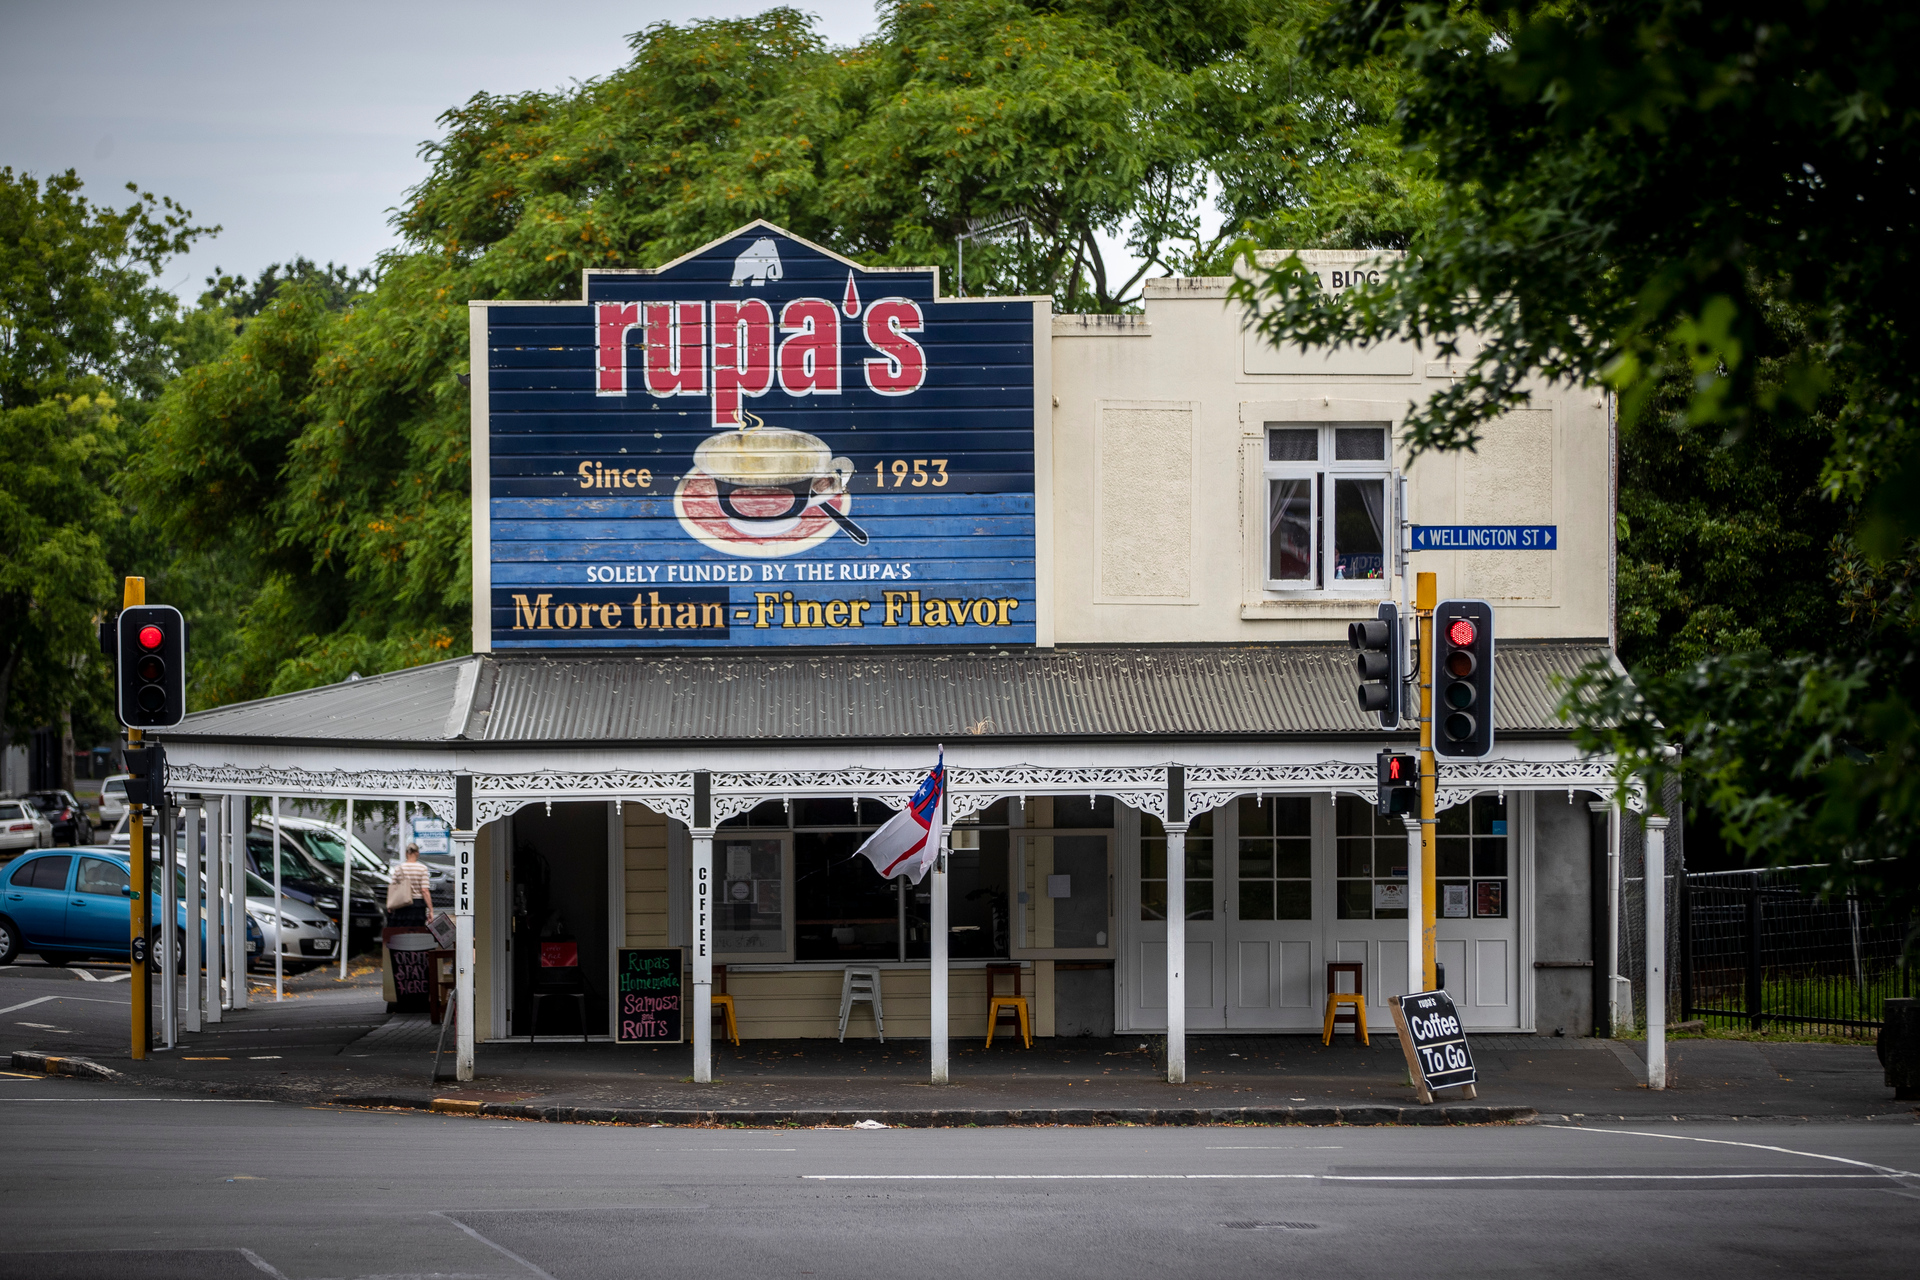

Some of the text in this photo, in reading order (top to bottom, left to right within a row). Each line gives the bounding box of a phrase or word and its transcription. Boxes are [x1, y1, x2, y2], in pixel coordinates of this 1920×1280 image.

[1332, 270, 1380, 288] BLDG
[594, 268, 927, 428] rupa's
[578, 459, 949, 488] Since 1953
[1429, 529, 1540, 546] WELLINGTON ST
[586, 563, 912, 582] SOLELY FUNDED BY THE RUPA'S
[511, 593, 623, 630] More
[632, 591, 726, 629] than
[881, 589, 1019, 627] Flavor
[461, 851, 469, 911] OPEN
[699, 867, 707, 957] COFFEE
[628, 952, 670, 975] Rupa's
[397, 980, 429, 995] HERE
[1418, 997, 1437, 1009] rupa's
[641, 1013, 655, 1021] and
[1411, 1012, 1460, 1041] Coffee
[1422, 1044, 1467, 1073] To Go
